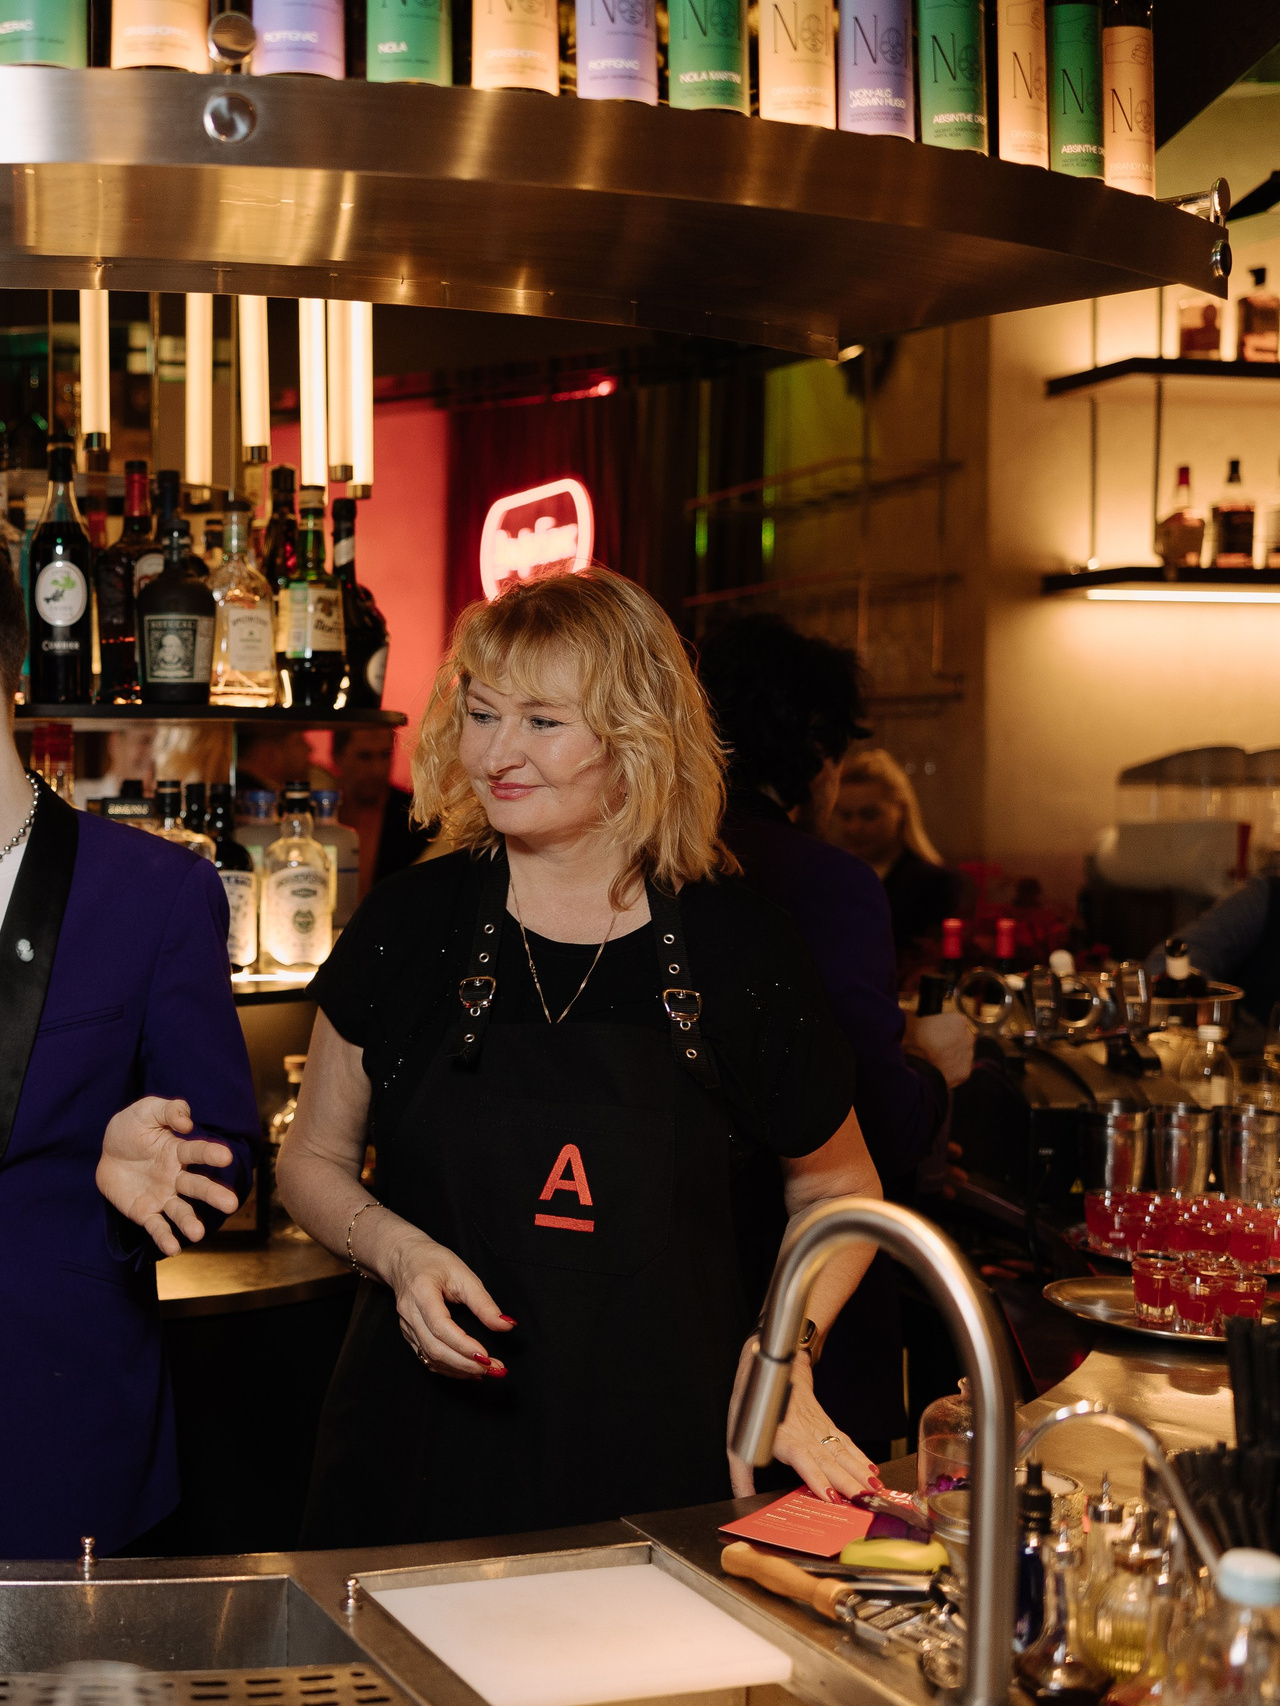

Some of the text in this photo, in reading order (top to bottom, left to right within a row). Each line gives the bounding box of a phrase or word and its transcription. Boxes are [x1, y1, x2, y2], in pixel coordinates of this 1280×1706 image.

[377, 41, 408, 54] NOLA
[678, 71, 708, 83] NOLA
[933, 113, 973, 124] ABSINTHE
[1061, 144, 1097, 155] ABSINTHE
[539, 1143, 593, 1206] A
